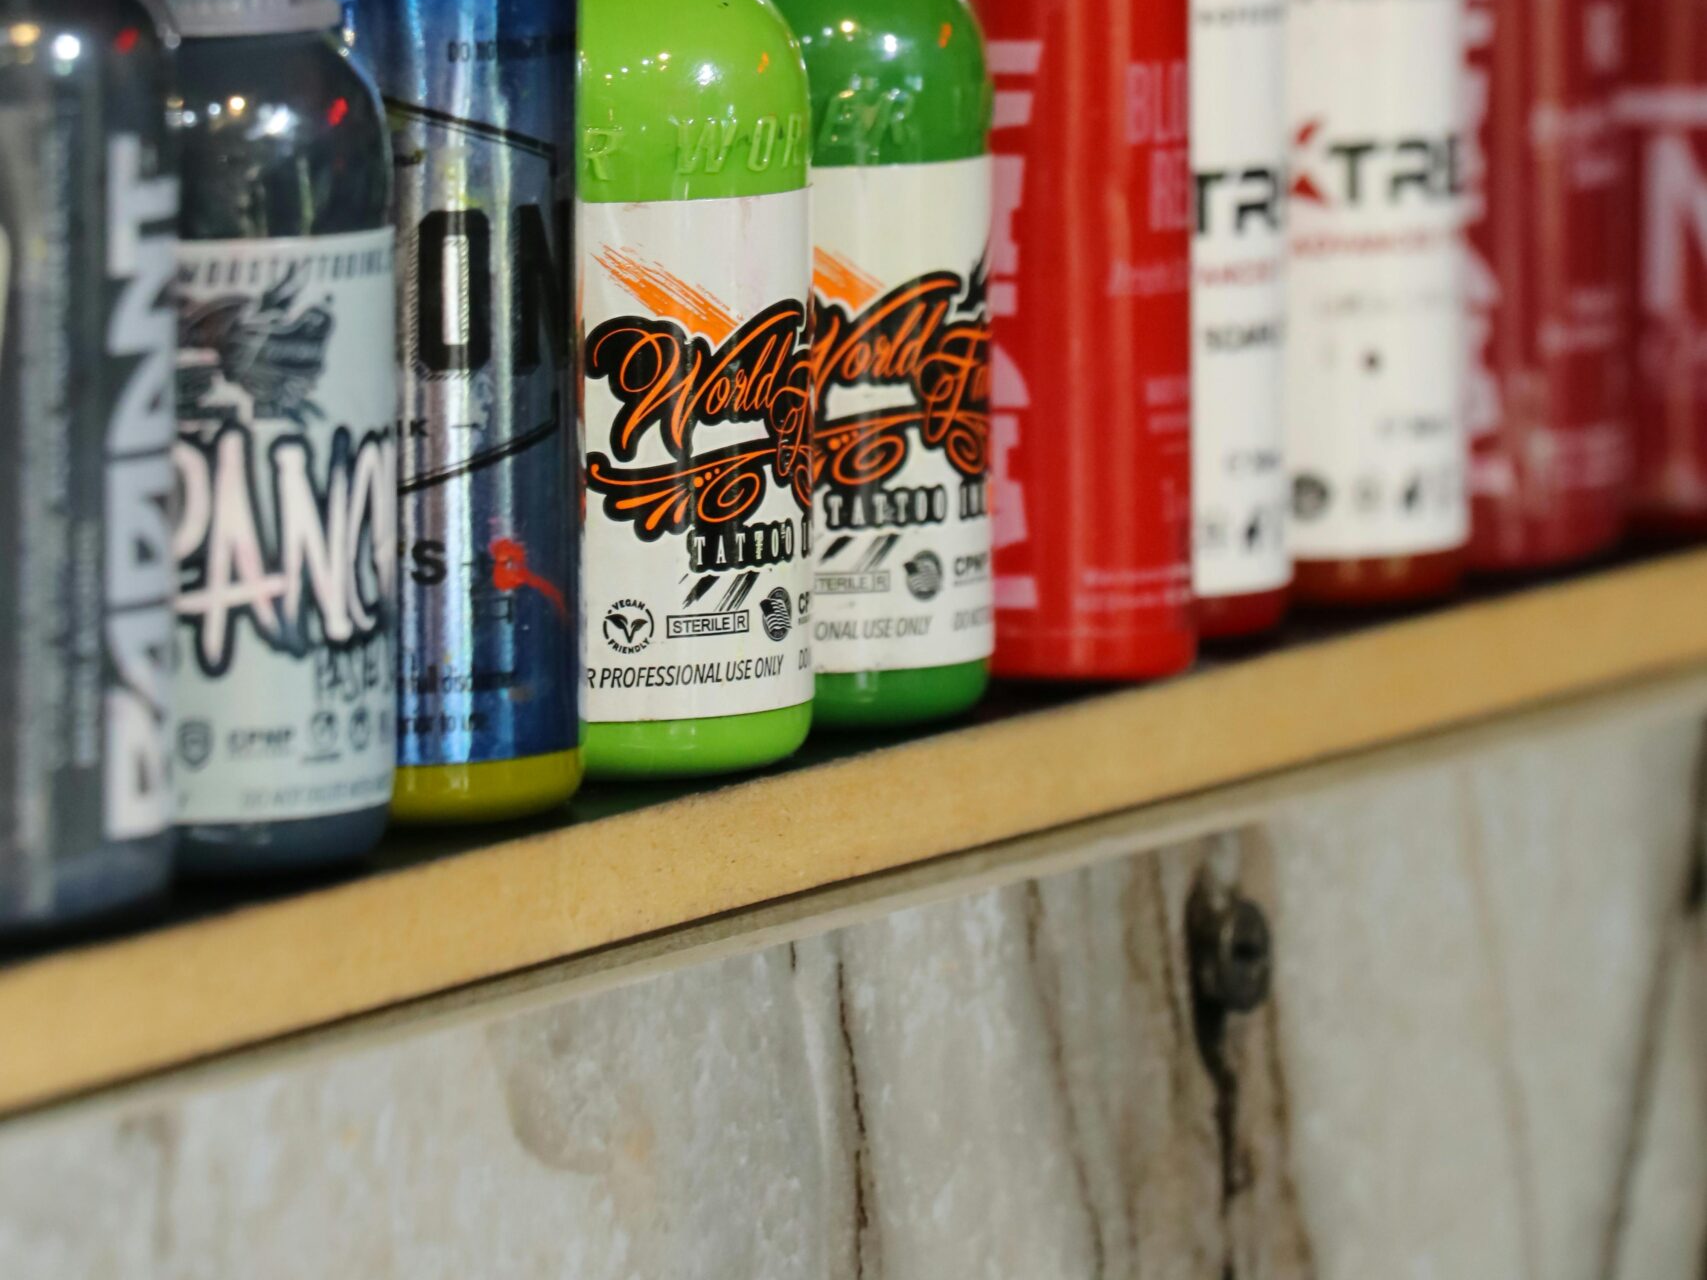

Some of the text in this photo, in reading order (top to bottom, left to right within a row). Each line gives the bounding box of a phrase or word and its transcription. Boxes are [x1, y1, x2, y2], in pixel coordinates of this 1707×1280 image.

[594, 310, 800, 452] World
[828, 486, 946, 527] TATTOO
[693, 523, 793, 566] TATTOO
[611, 598, 646, 611] VEGAN
[672, 614, 746, 634] STERILE R
[607, 637, 650, 655] FRIENDLY
[599, 663, 722, 689] PROFESSIONAL
[726, 658, 751, 682] USE
[754, 654, 785, 679] ONLY
